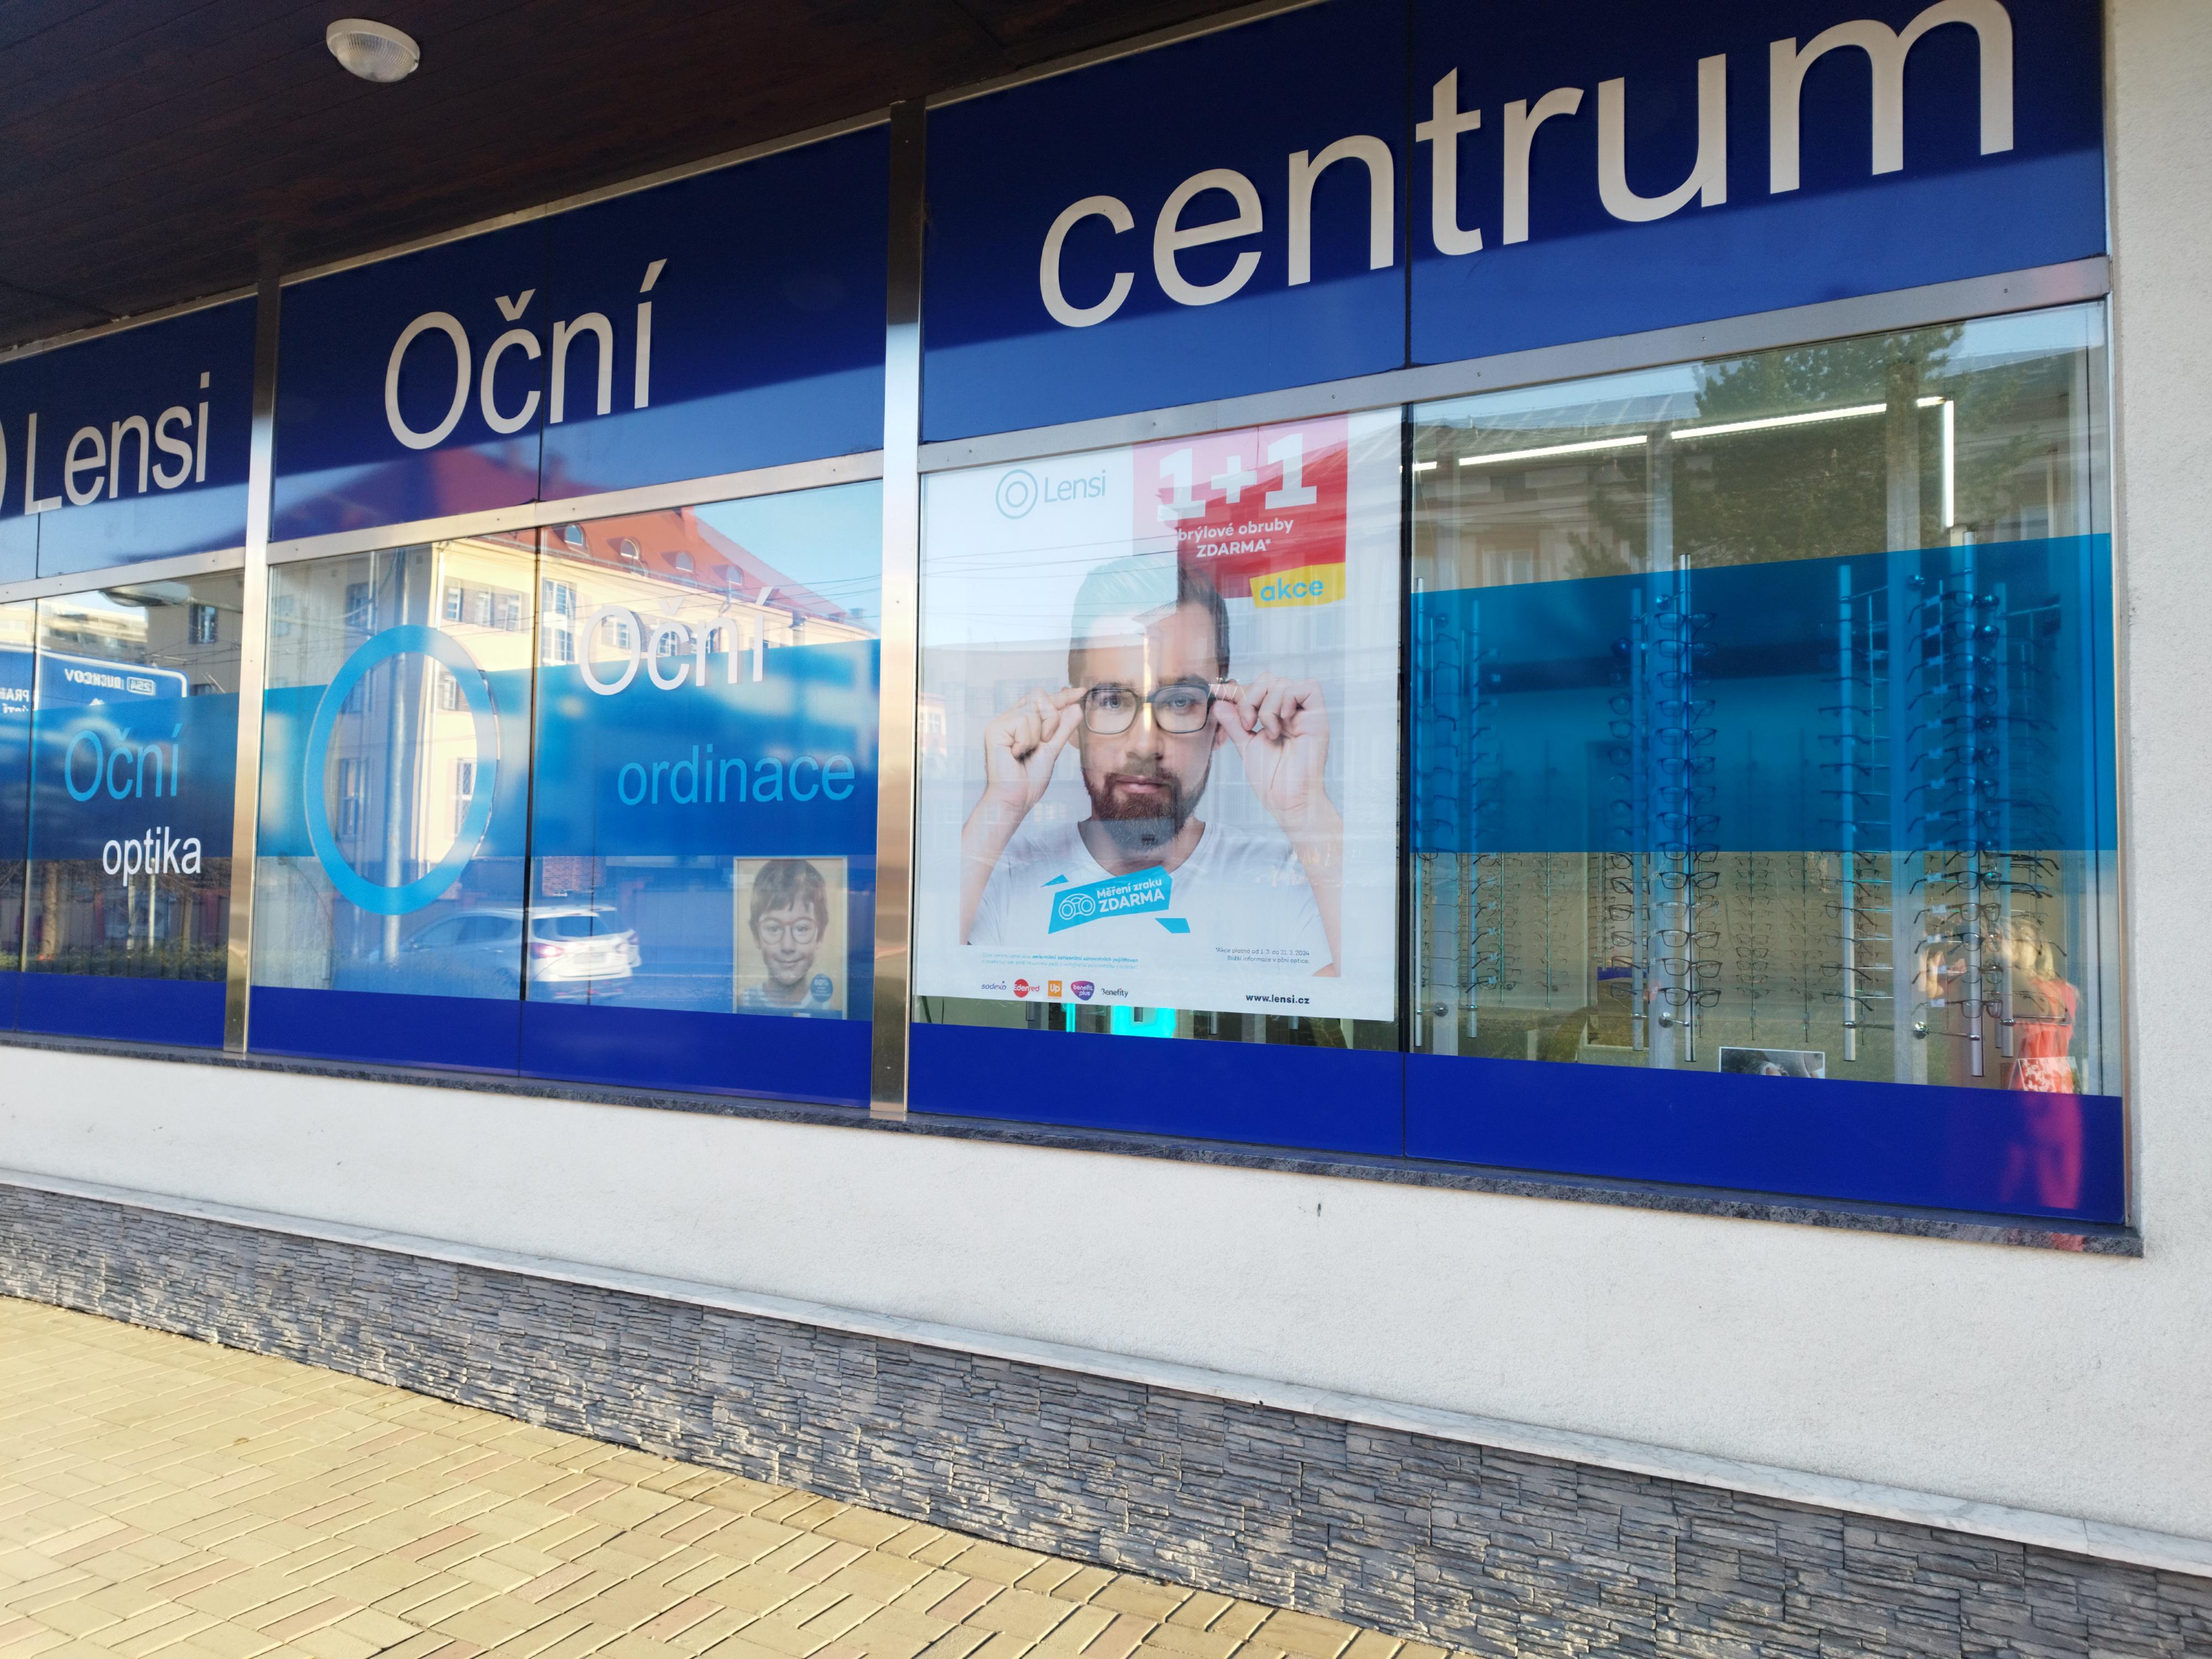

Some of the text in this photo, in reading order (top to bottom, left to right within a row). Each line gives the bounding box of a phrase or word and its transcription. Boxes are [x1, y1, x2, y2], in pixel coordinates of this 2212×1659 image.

[25, 0, 2014, 515] Lensi Oční centrum
[1044, 469, 1106, 503] Lensi
[1157, 433, 1317, 521] 1+1
[1177, 518, 1293, 543] brýlové obruby
[1260, 578, 1324, 601] akce
[578, 587, 773, 695] Oční
[65, 723, 182, 801] Oční
[618, 744, 855, 805] ordinace
[103, 826, 201, 886] optika
[1097, 878, 1162, 899] Měření zraku
[1098, 888, 1165, 912] ZDARMA
[982, 980, 1006, 990] sodexo
[1013, 983, 1040, 992] Edenred
[1050, 983, 1061, 994] Up
[1246, 994, 1310, 1004] www.lensi.cz
